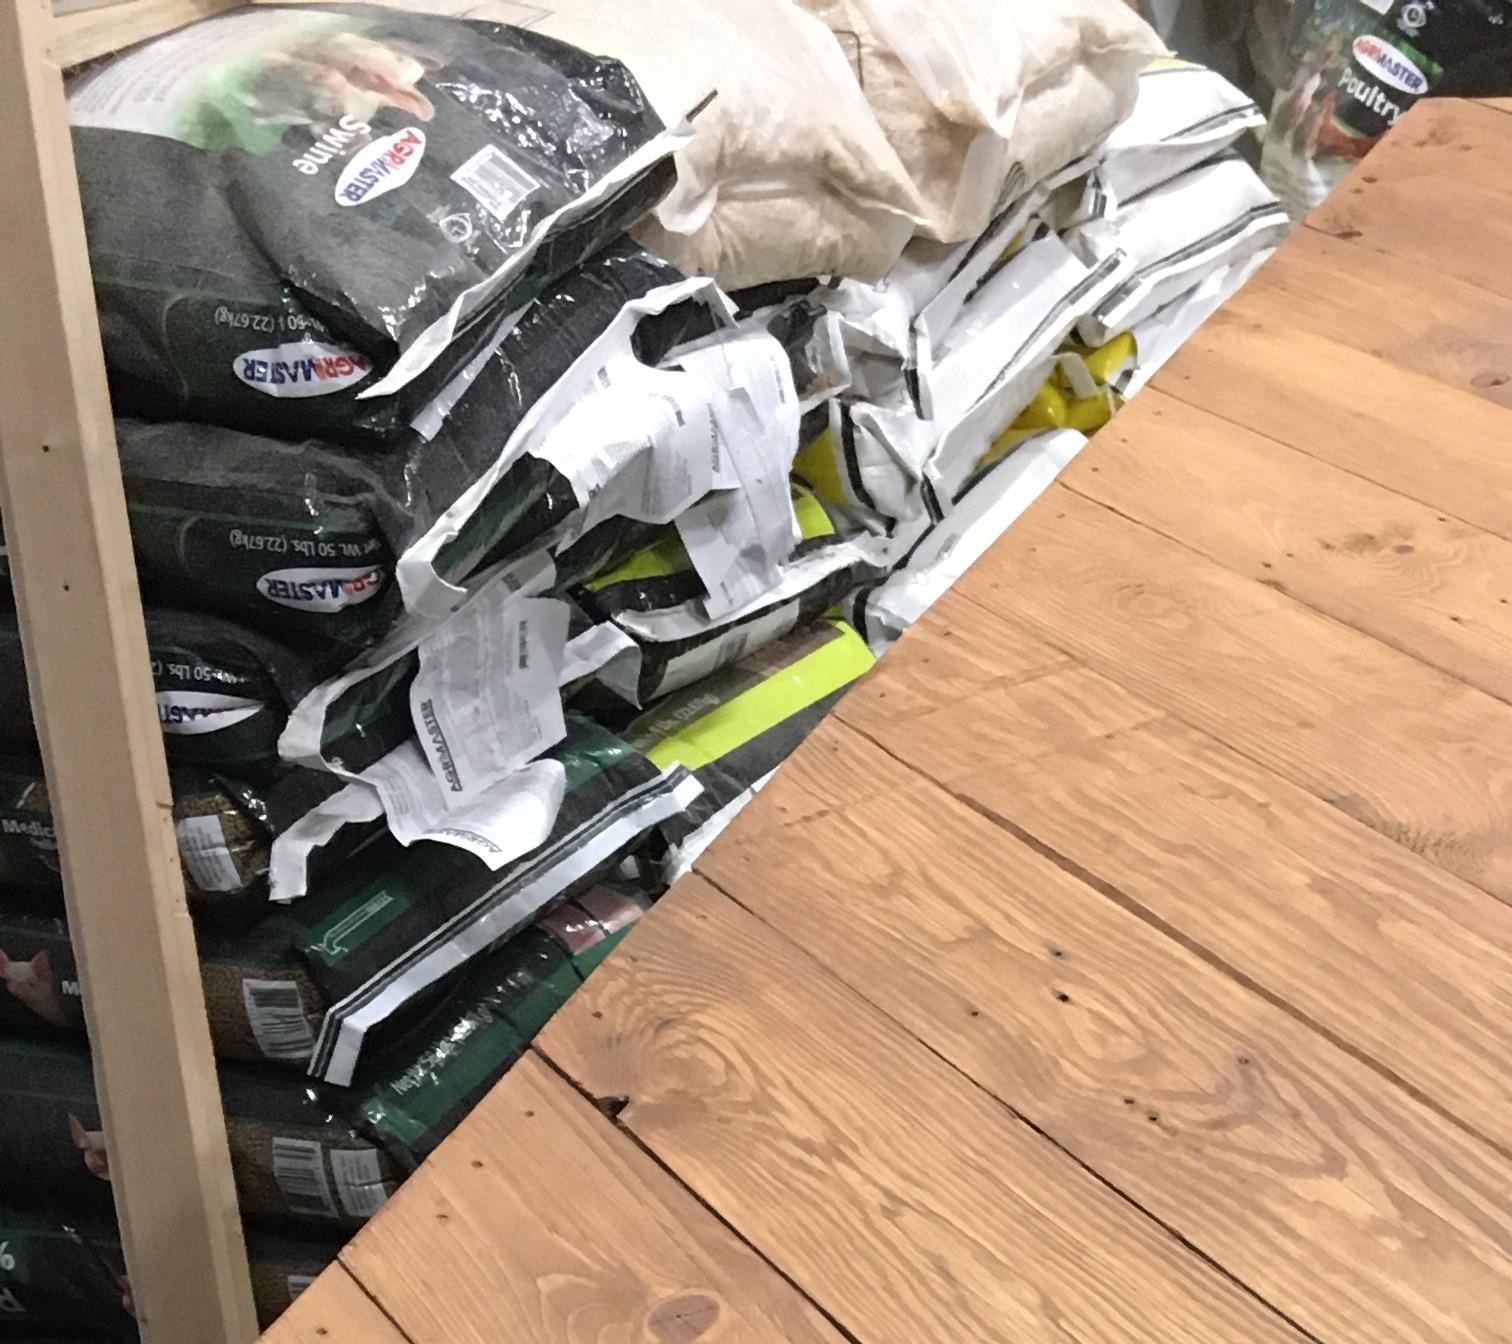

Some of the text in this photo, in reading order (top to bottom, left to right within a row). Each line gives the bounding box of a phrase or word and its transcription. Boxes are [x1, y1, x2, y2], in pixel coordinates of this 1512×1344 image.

[1338, 67, 1404, 126] Poultry
[292, 114, 372, 175] Swine
[229, 528, 288, 553] (22.67kg)
[317, 541, 336, 558] 50
[193, 665, 212, 682] 50
